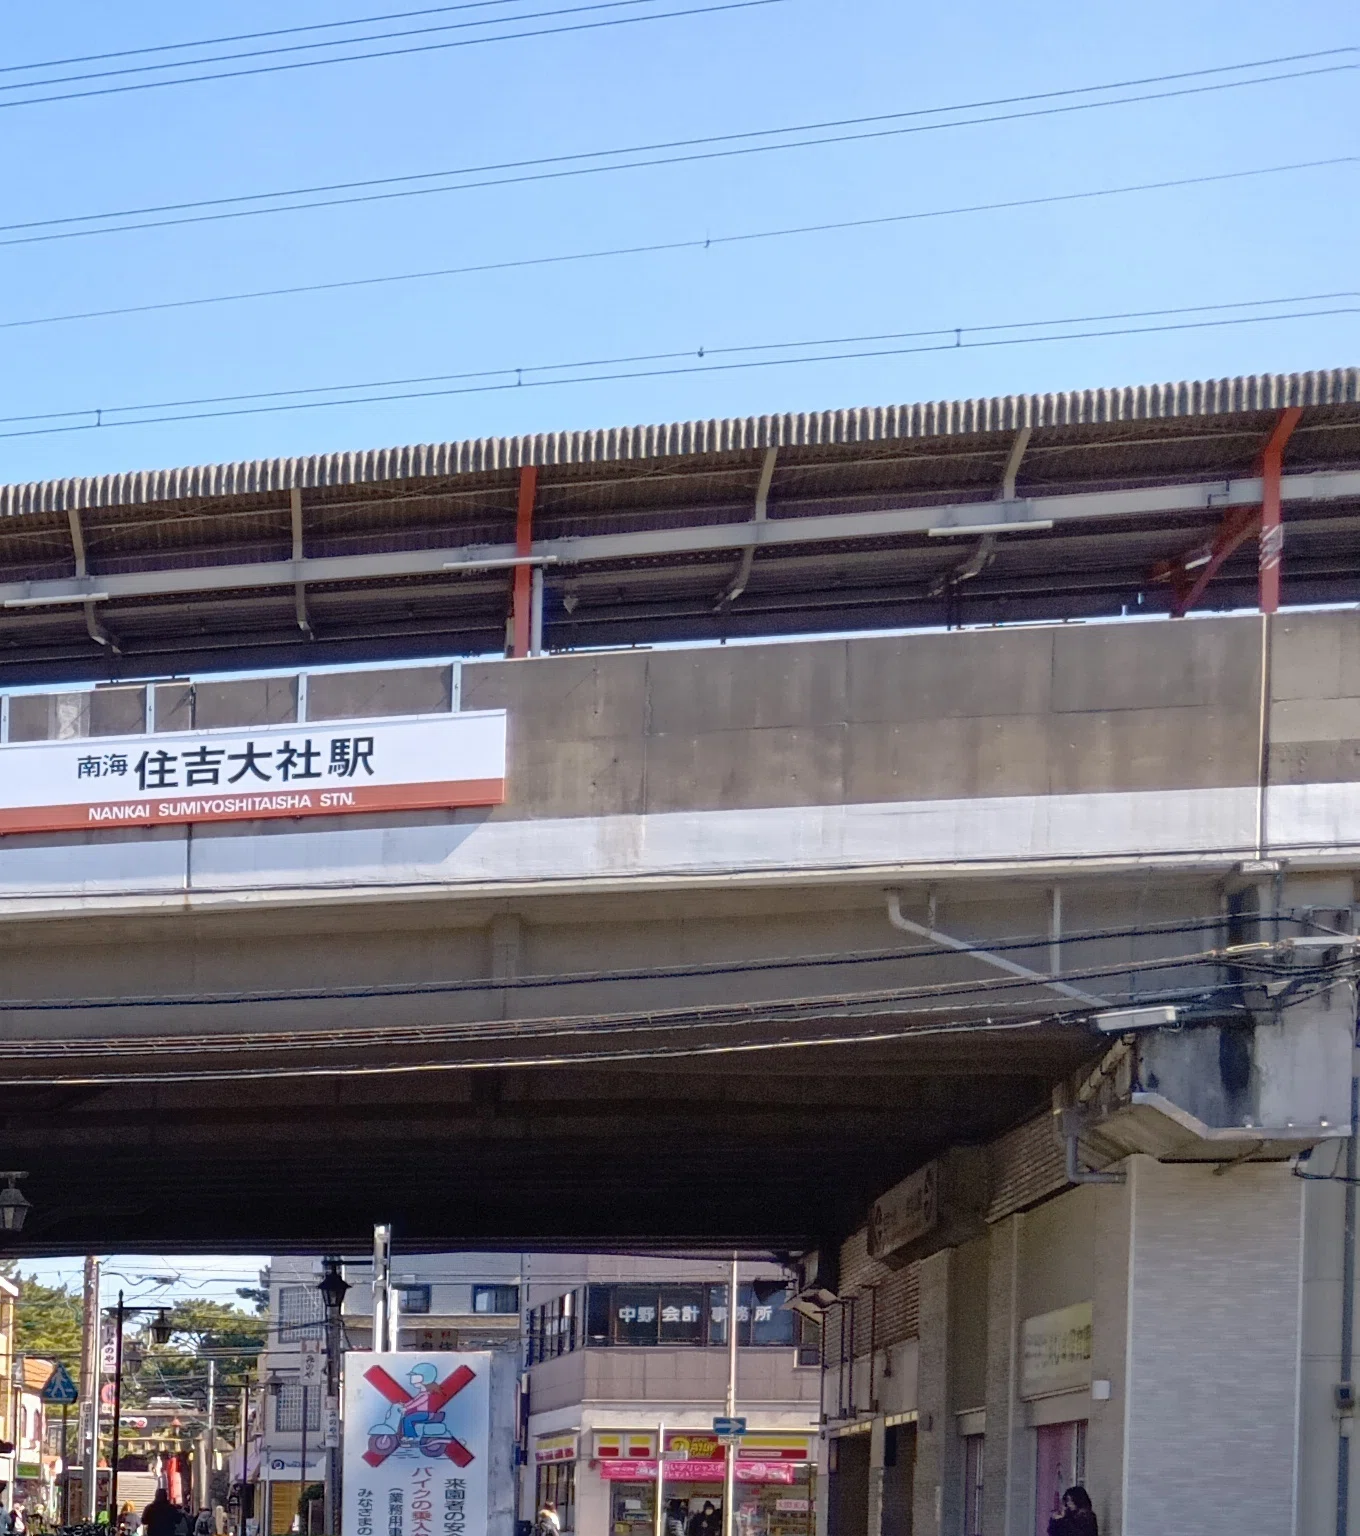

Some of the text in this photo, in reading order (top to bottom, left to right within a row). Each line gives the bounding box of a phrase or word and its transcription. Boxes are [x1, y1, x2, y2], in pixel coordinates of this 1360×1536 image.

[77, 736, 375, 791] 南海 住吉大社駅
[88, 792, 356, 821] NANKAI SUMIYOSHITAISHA STN.
